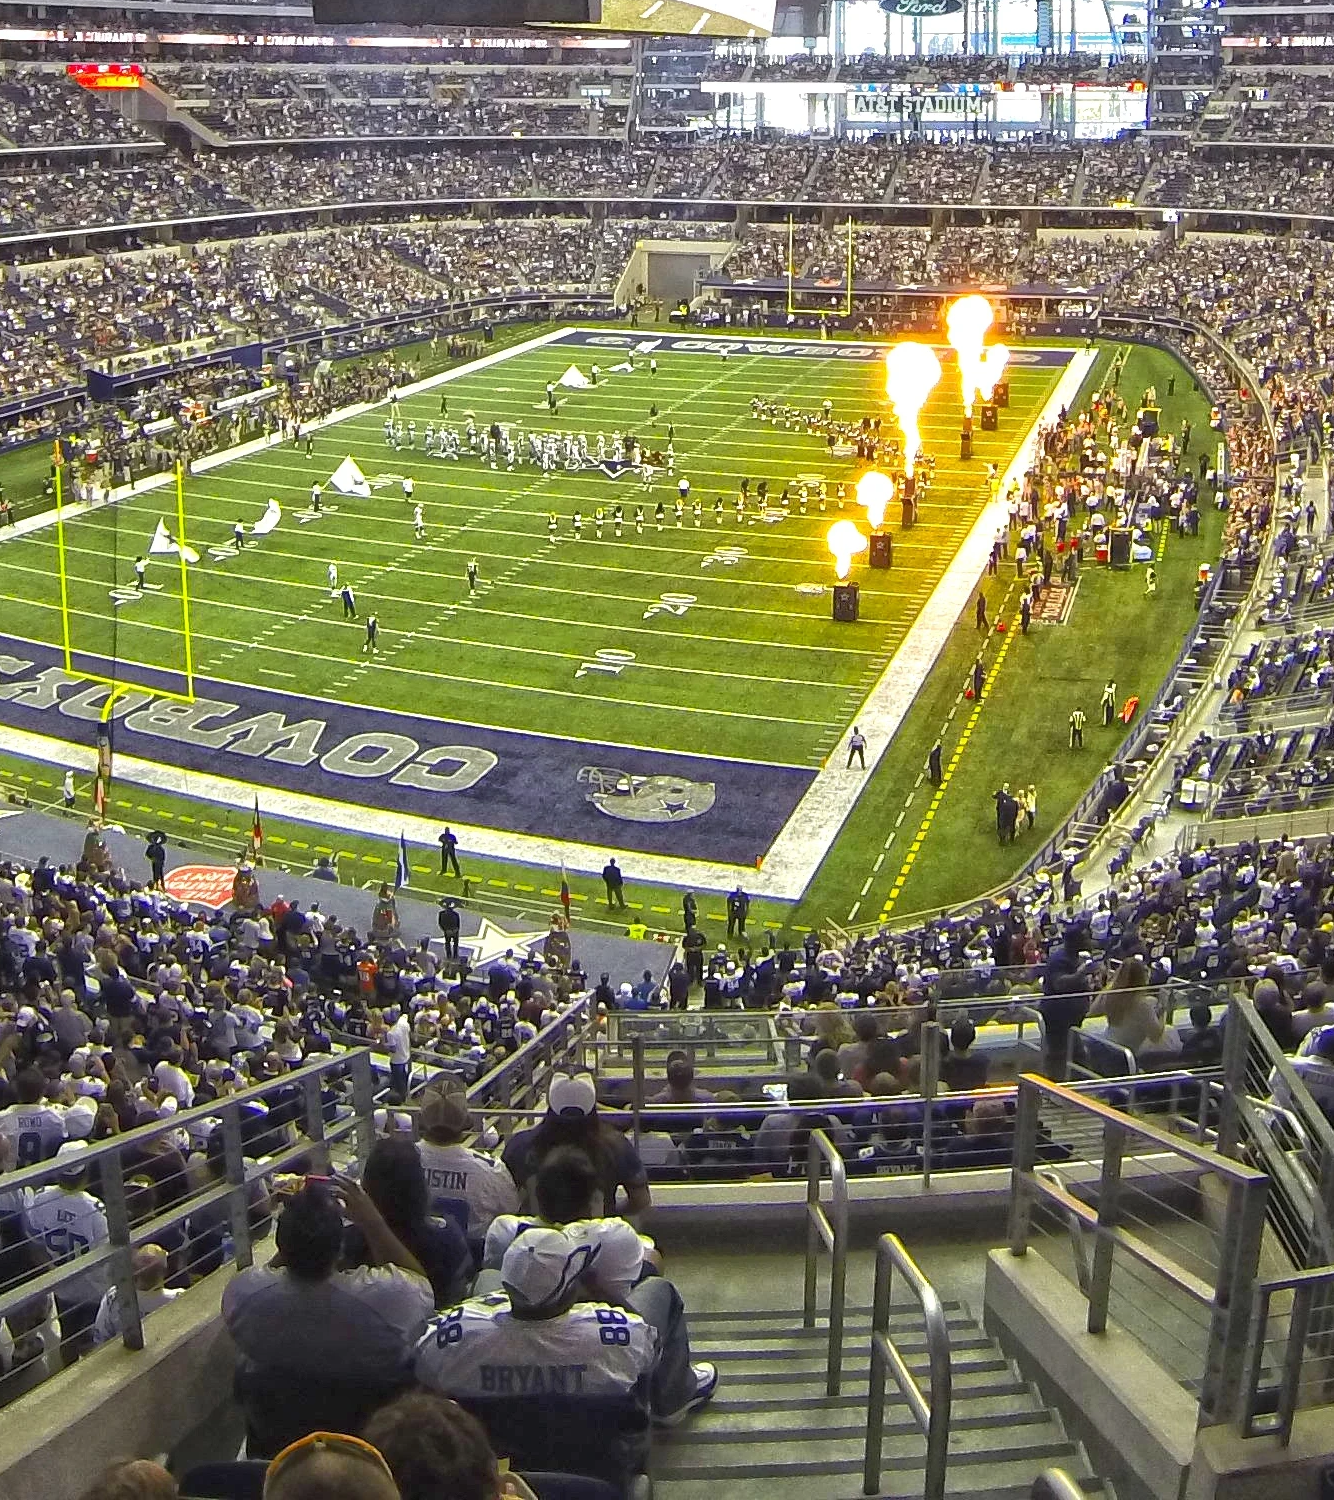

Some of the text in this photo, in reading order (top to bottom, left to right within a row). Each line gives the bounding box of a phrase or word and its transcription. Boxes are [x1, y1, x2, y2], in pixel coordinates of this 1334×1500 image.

[855, 96, 983, 113] AT&T STADIUM
[645, 593, 698, 616] 20
[579, 648, 636, 675] 10
[181, 891, 222, 899] THE
[18, 1116, 42, 1128] ROMO
[424, 1168, 467, 1190] USTIN
[436, 1306, 463, 1349] 88
[595, 1309, 631, 1346] 88
[479, 1364, 587, 1392] BRYANT
